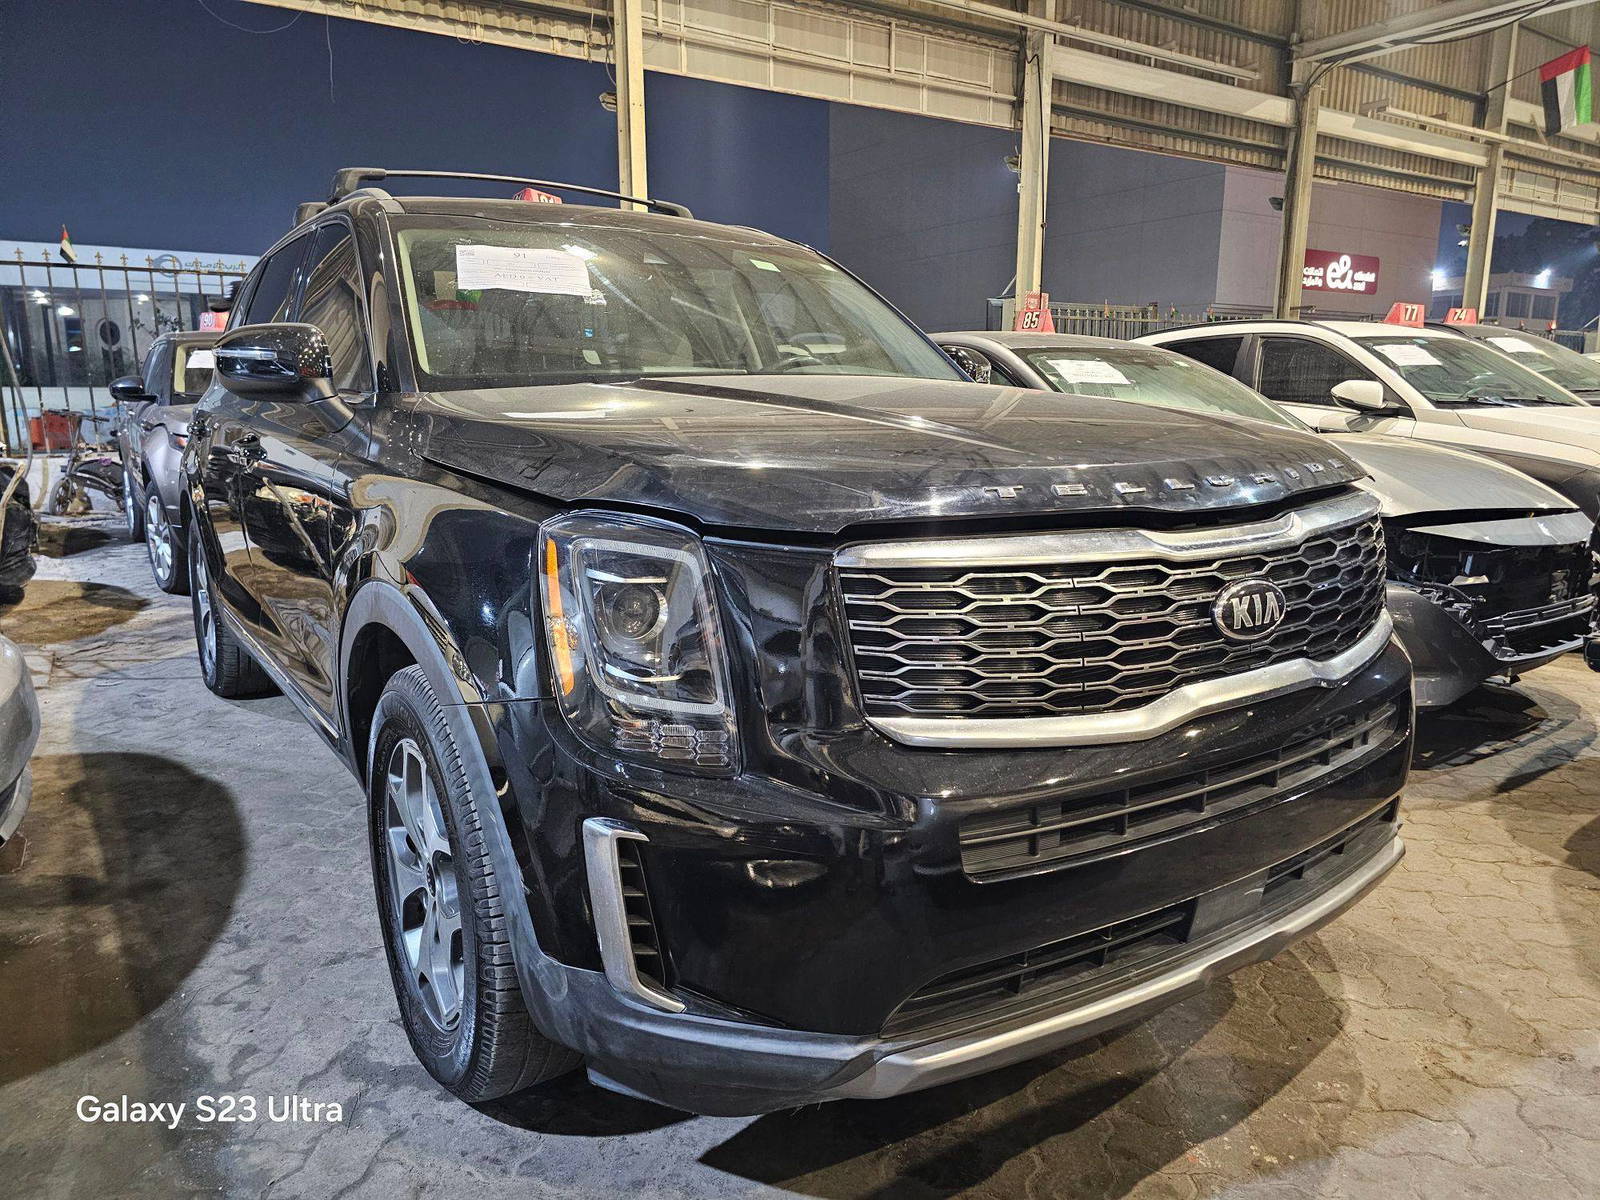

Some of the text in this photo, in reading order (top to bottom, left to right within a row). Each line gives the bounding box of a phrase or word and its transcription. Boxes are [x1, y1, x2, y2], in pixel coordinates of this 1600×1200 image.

[203, 312, 214, 328] 90
[1022, 311, 1040, 329] 85
[1404, 305, 1418, 321] 77
[1453, 308, 1467, 321] 74
[1230, 591, 1281, 630] KIA
